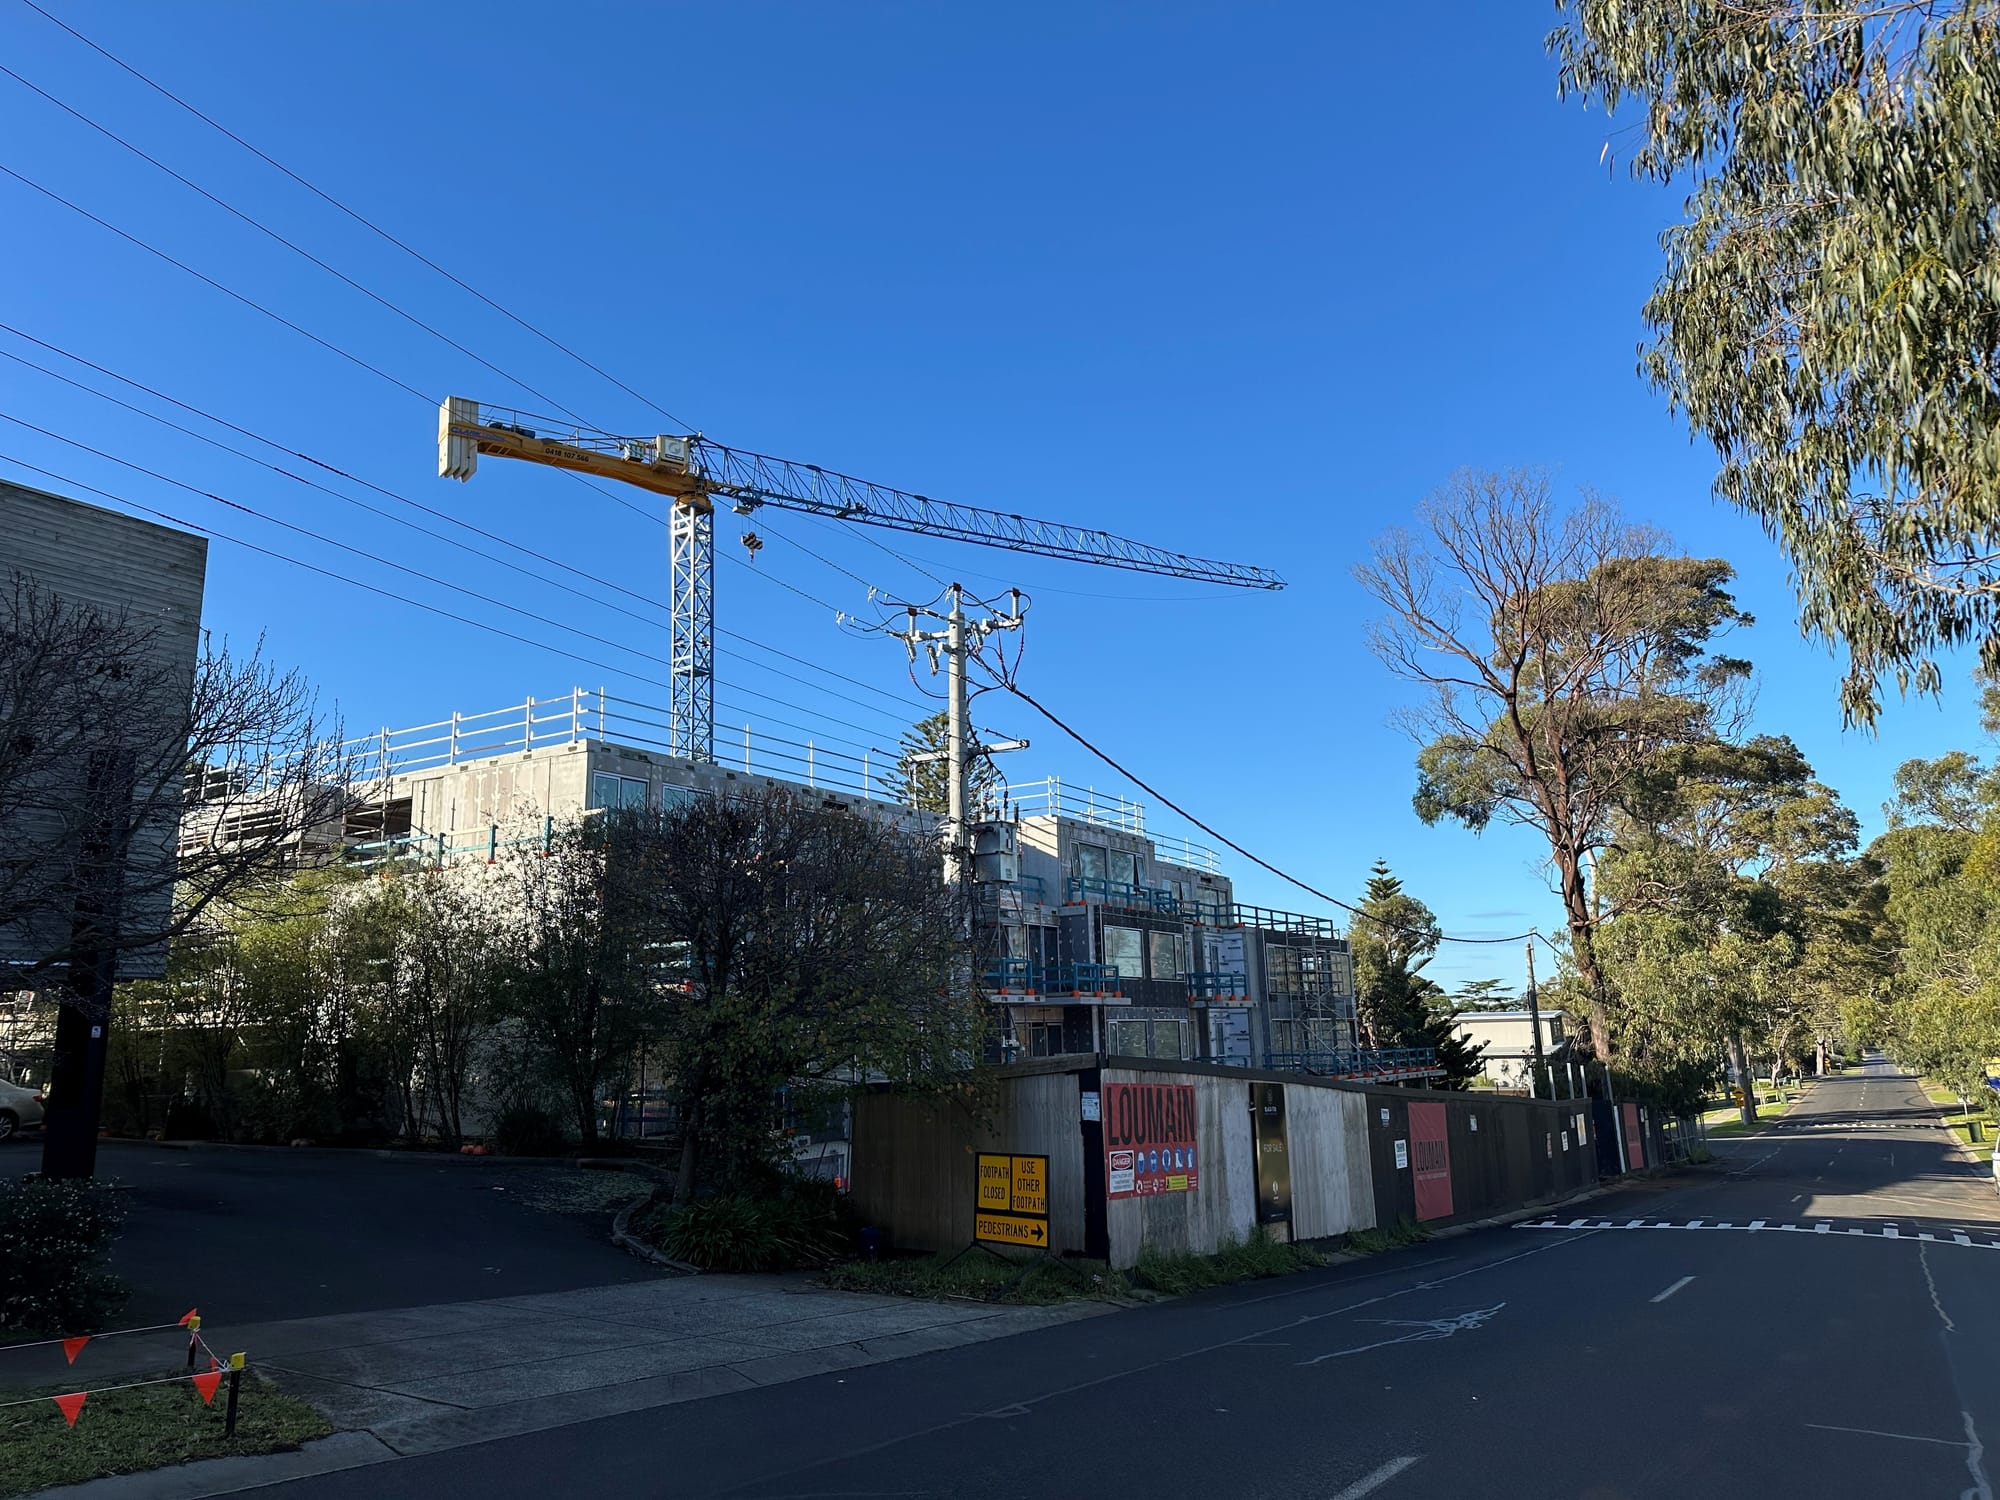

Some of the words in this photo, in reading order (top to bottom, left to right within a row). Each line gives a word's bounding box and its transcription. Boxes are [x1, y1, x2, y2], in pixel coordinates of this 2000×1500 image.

[545, 447, 562, 457] 0418
[564, 451, 575, 459] 107
[1106, 1086, 1195, 1146] LOUMAIN
[1415, 1140, 1447, 1171] LOUMAIN
[980, 1165, 1010, 1179] FOOTPATH
[1021, 1160, 1036, 1175] USE
[983, 1185, 1006, 1200] CLOSED
[1017, 1178, 1040, 1193] OTHER
[1012, 1195, 1045, 1211] FOOTPATH
[978, 1220, 1029, 1239] PEDESTRIANS
